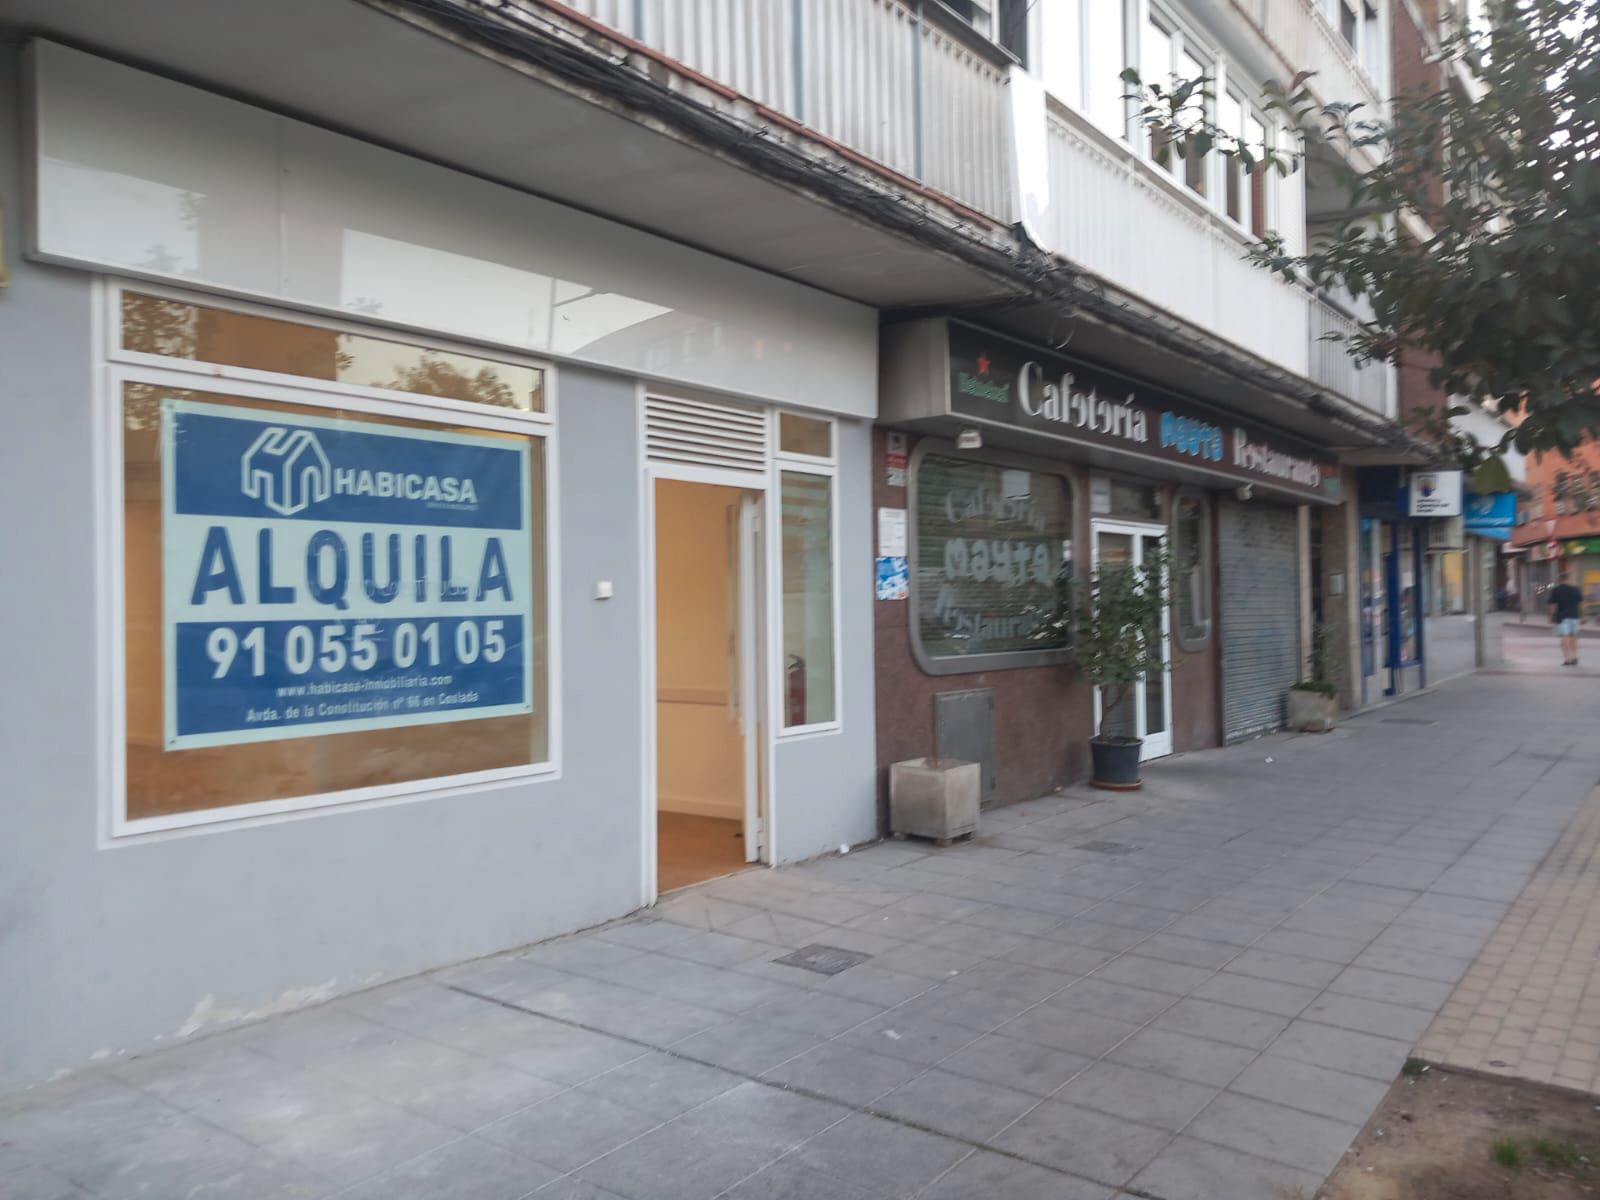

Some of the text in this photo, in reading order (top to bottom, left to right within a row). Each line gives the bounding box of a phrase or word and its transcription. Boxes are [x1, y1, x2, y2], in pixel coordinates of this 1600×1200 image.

[334, 468, 478, 504] HABICASA
[189, 526, 514, 610] ALQUILA
[207, 619, 506, 679] 91 055 01 05
[276, 675, 453, 697] www.habicasa-inmobiliaria.com
[246, 708, 282, 722] Avda.
[286, 708, 299, 719] de
[304, 705, 315, 717] la
[319, 696, 389, 716] Constitución
